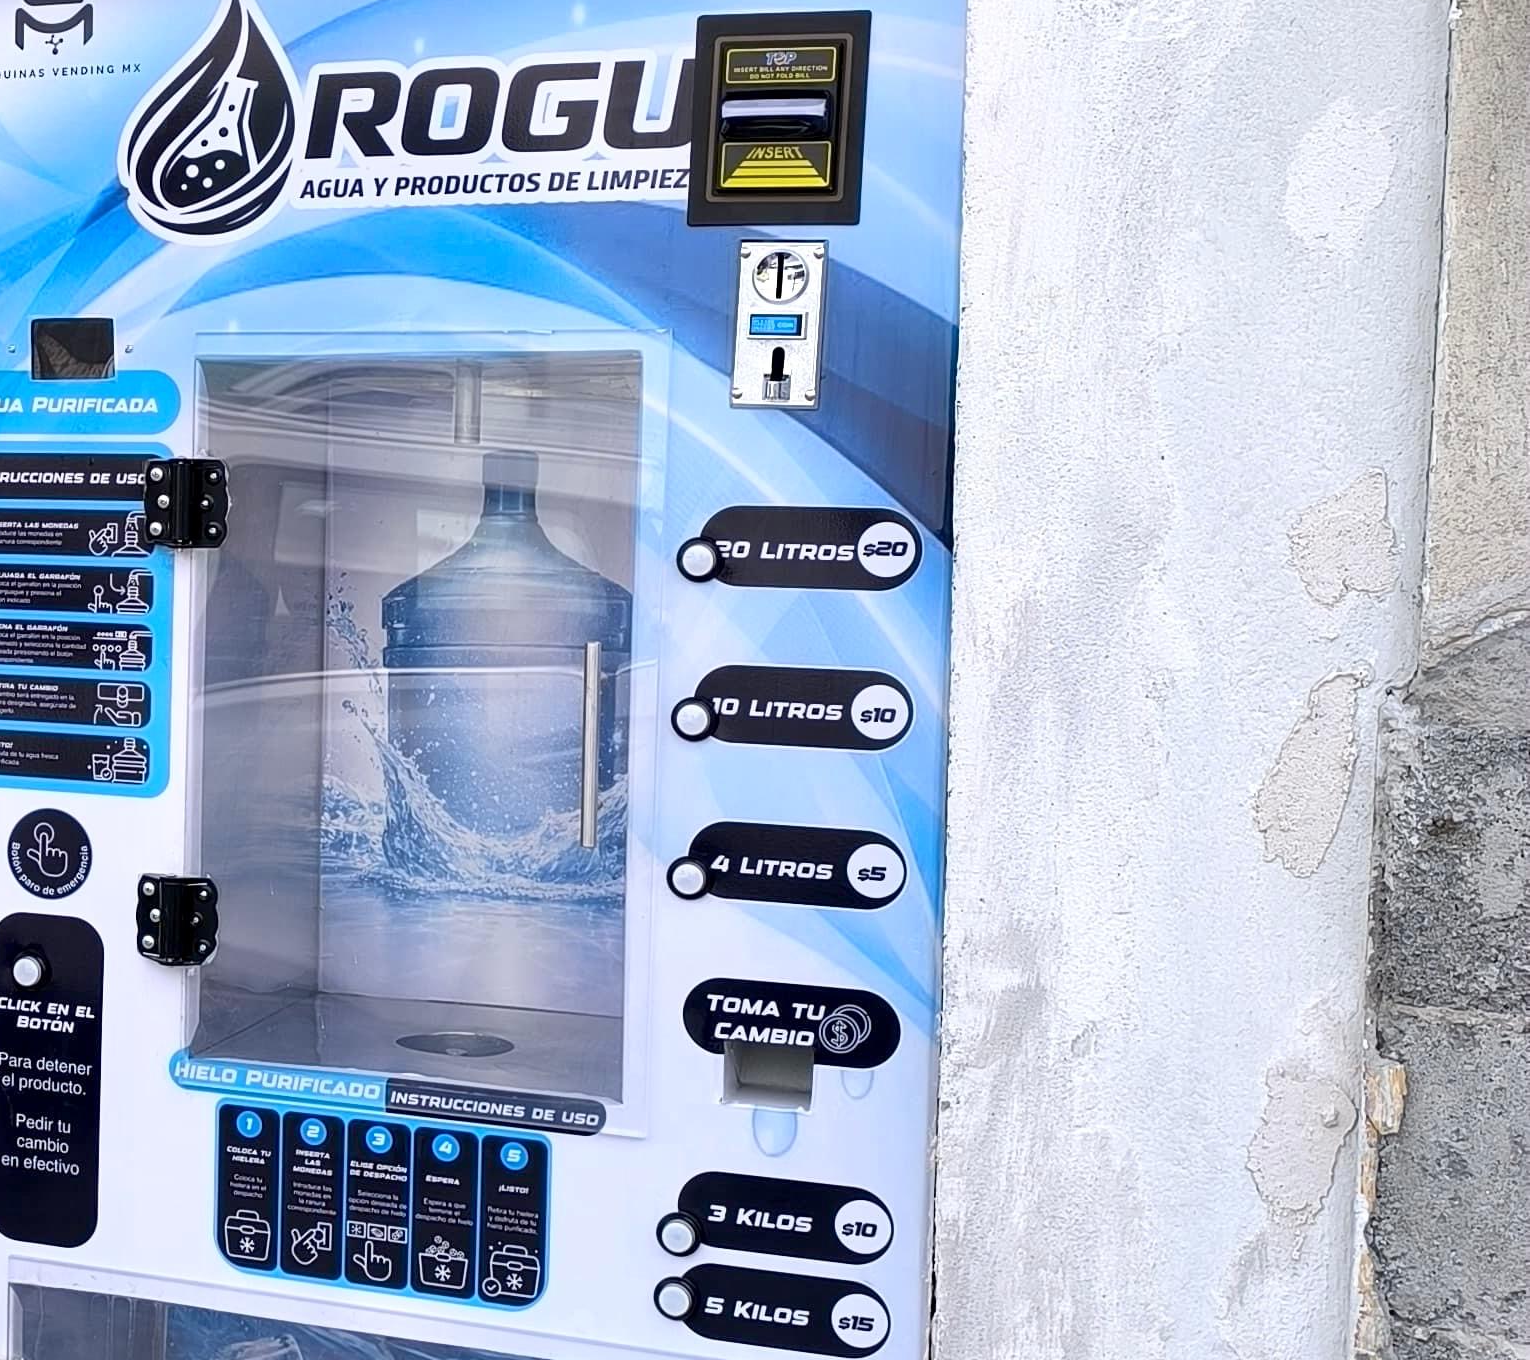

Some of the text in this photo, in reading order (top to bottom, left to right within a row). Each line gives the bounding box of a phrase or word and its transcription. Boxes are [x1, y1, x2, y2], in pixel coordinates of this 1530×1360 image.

[52, 64, 115, 76] VENDING
[122, 64, 141, 73] MX
[304, 59, 695, 160] ROGU
[745, 146, 804, 160] INSERT
[300, 168, 690, 199] AGUA Y PRODUCTOS DE LIMPIEZ
[32, 397, 158, 413] PURIFICADA
[90, 473, 110, 485] DE
[715, 541, 908, 561] 20 LITROS $20
[712, 697, 896, 723] 10 LITROS $10
[19, 874, 40, 892] paro
[42, 885, 55, 895] de
[57, 845, 89, 894] emergencia
[710, 855, 887, 882] 4 LITROS $5
[46, 1003, 69, 1016] EN
[75, 1006, 95, 1019] EL
[706, 994, 826, 1020] TOMA TU
[16, 1015, 75, 1034] BOTÓN
[714, 1022, 815, 1046] CAMBIO
[36, 1057, 93, 1076] detener
[2, 1073, 87, 1096] el producto.
[174, 1062, 381, 1100] HIELO PURIFICADO
[390, 1091, 600, 1126] INSTRUCCIONES DE USO
[15, 1113, 71, 1134] Pedir tu
[16, 1136, 69, 1154] cambio
[1, 1155, 80, 1176] en efectivo
[708, 1204, 877, 1237] 3 KILOS $10
[704, 1297, 875, 1332] 5 KILOS $15
